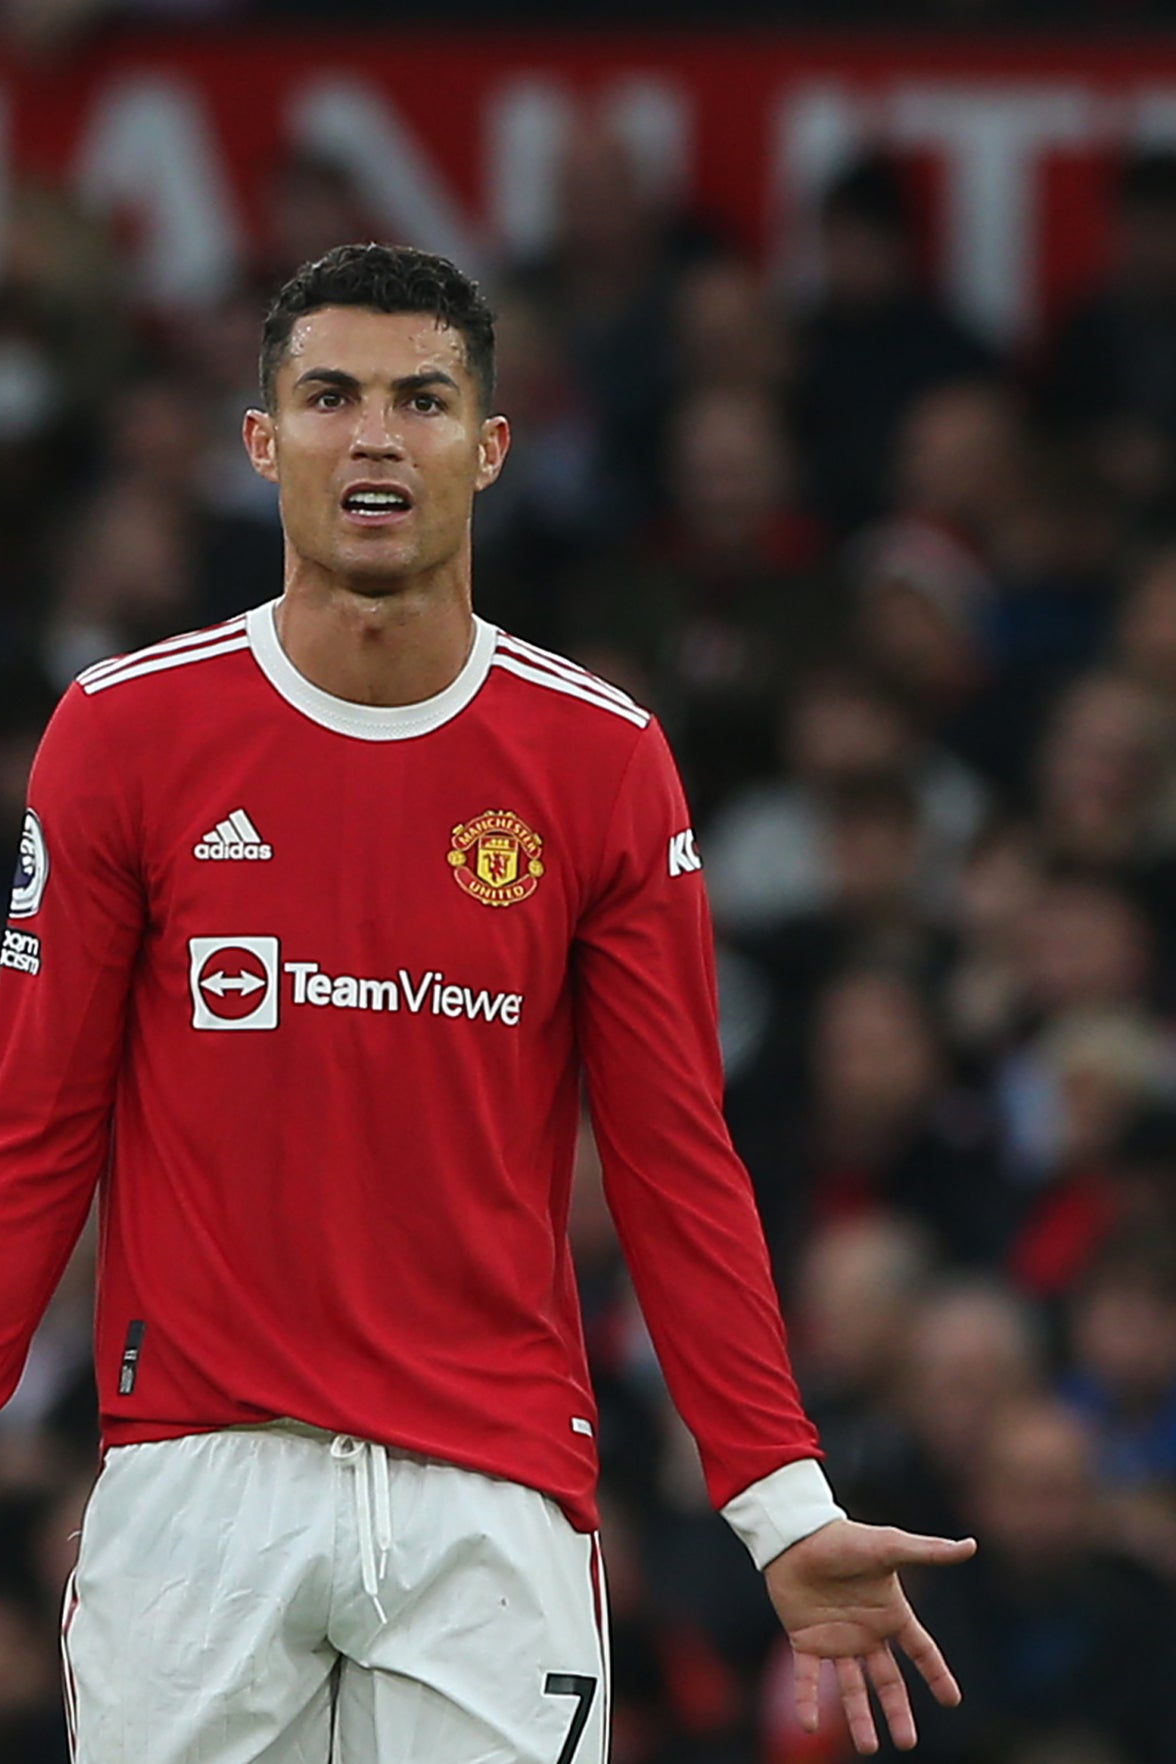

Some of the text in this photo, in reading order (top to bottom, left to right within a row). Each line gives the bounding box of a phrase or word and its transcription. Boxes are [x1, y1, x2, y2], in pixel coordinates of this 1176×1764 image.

[194, 841, 272, 860] adidas
[458, 817, 539, 853] MANCHESTER
[469, 881, 526, 900] UNITED
[284, 961, 523, 1026] TeamViewe
[543, 1672, 598, 1764] 7
